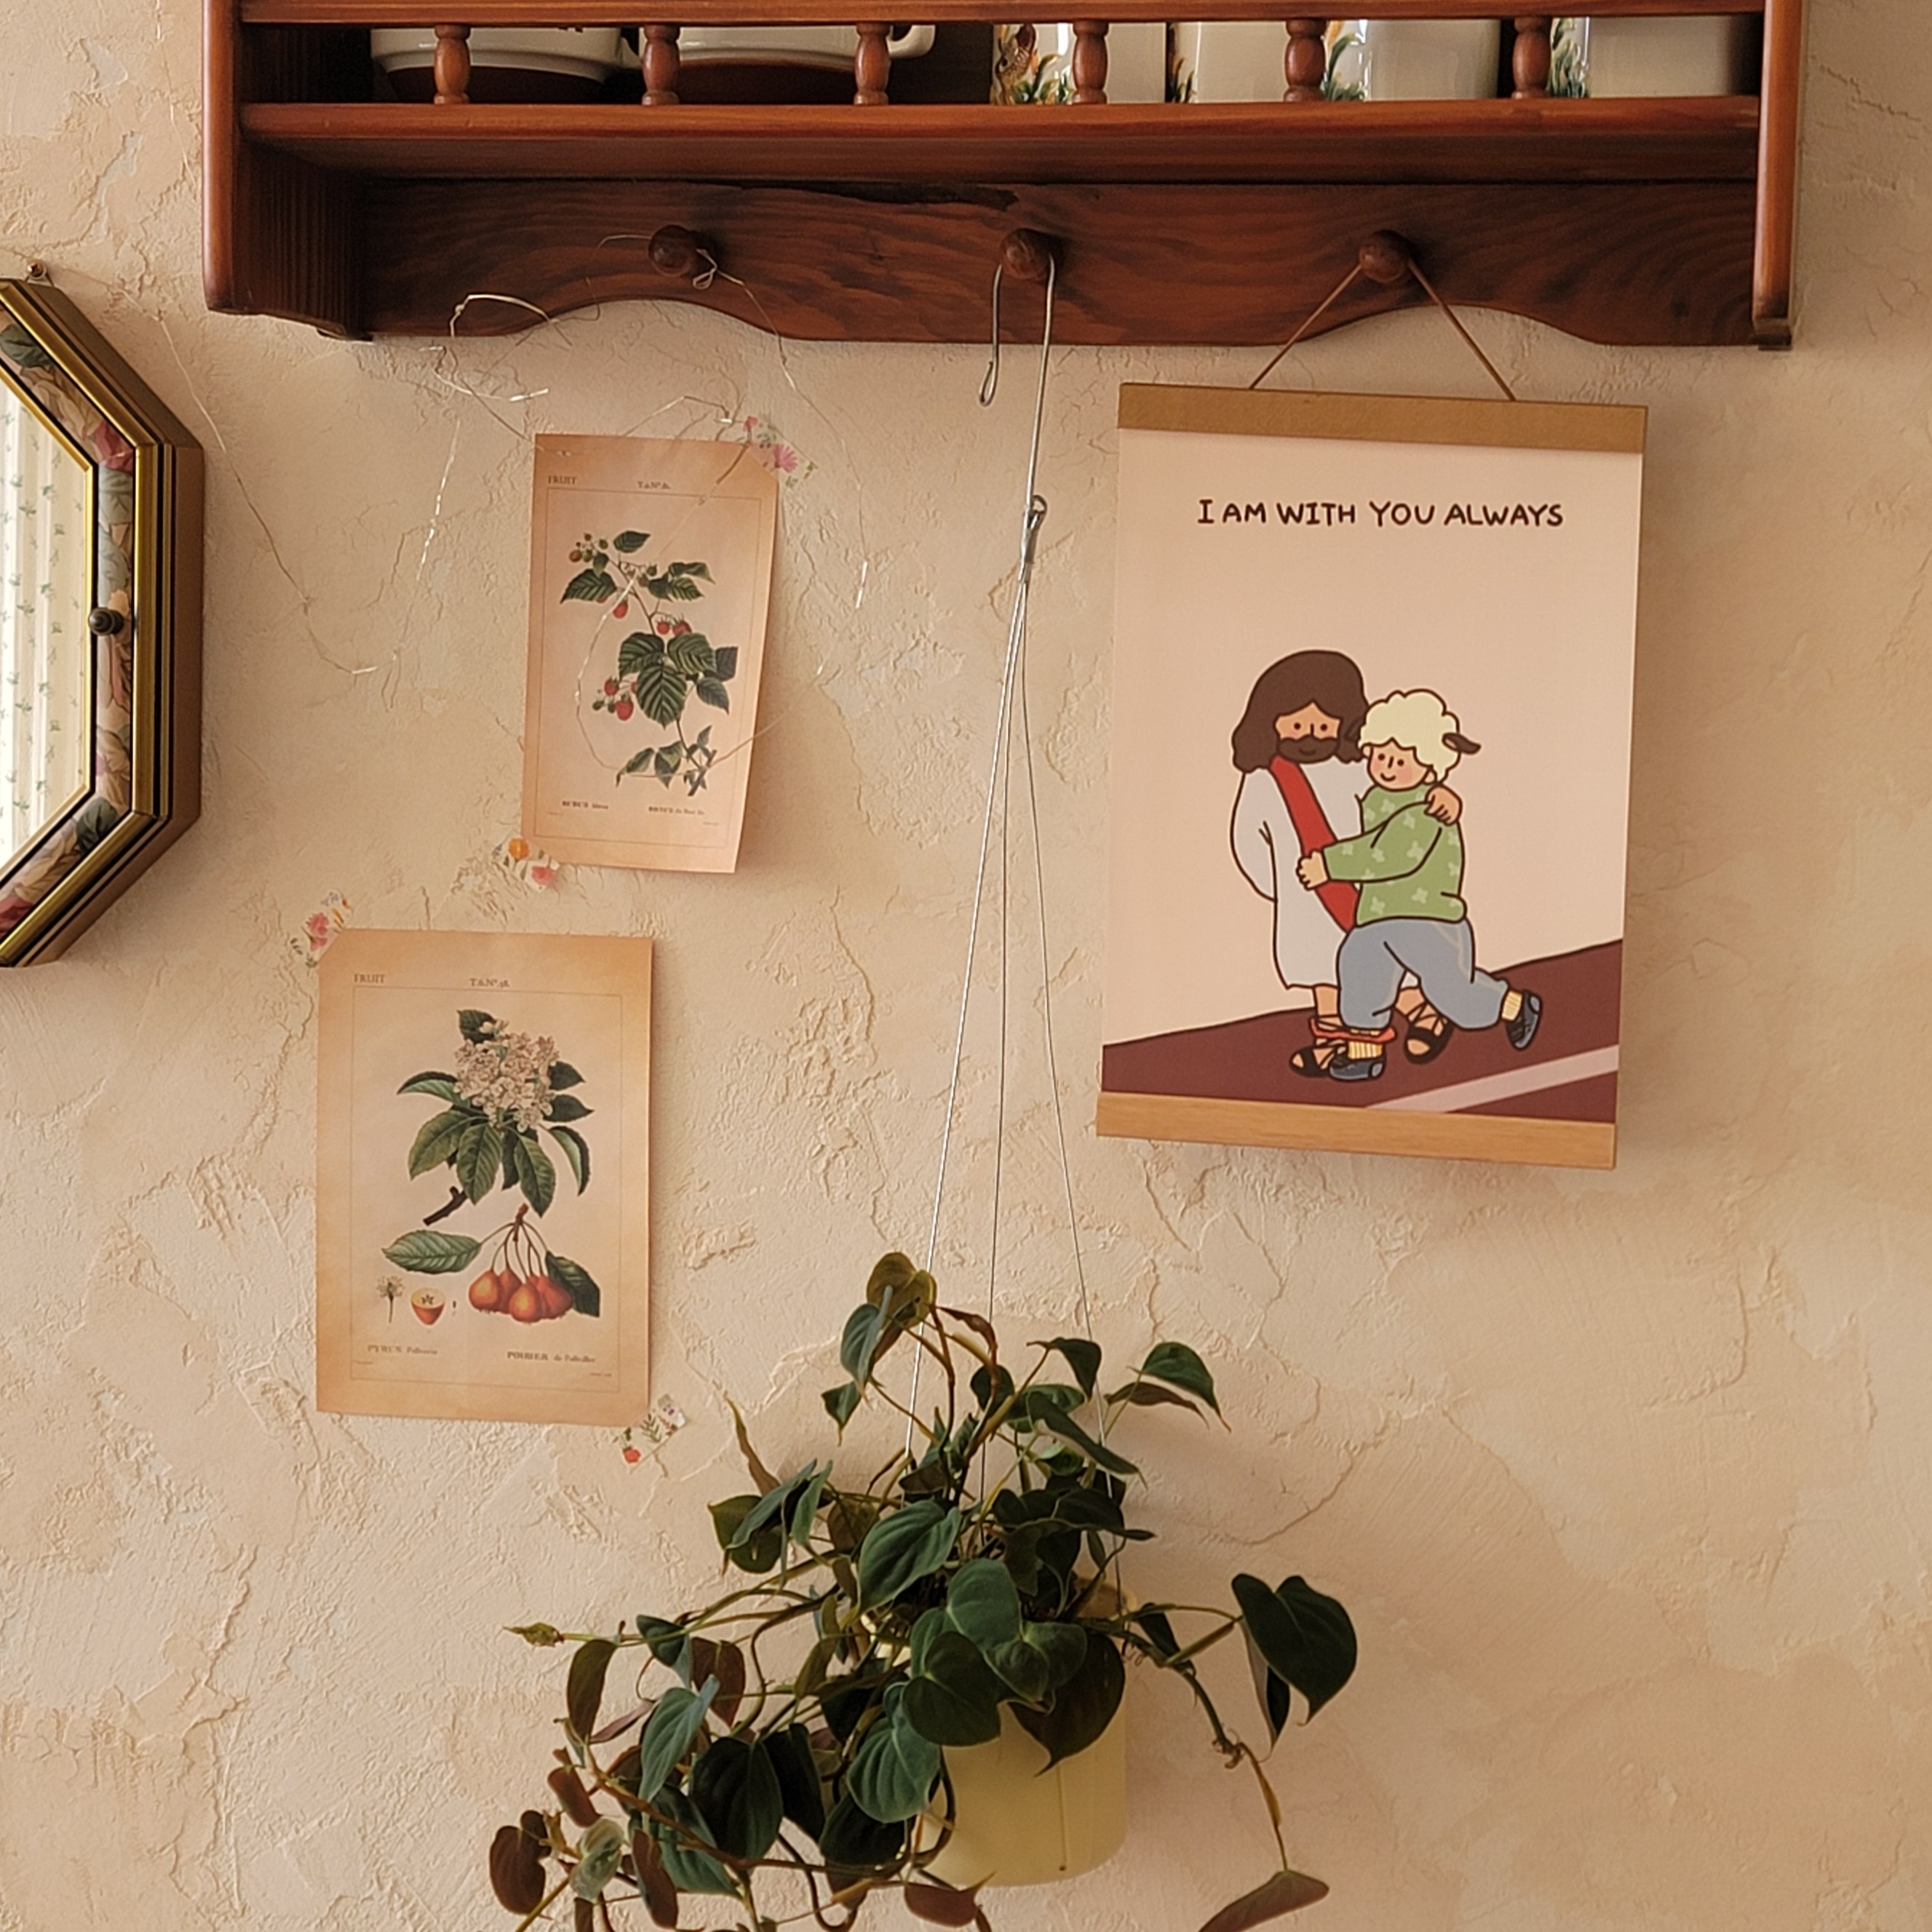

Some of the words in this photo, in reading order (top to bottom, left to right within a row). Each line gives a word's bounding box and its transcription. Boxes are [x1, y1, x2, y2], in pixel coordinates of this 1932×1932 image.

[548, 475, 577, 485] FRUIT
[1198, 499, 1215, 524] I
[1223, 503, 1267, 524] AM
[1276, 501, 1356, 526] WITH
[1370, 501, 1435, 527] YOU
[1444, 504, 1564, 527] ALWAYS
[354, 974, 386, 984] FRUIT
